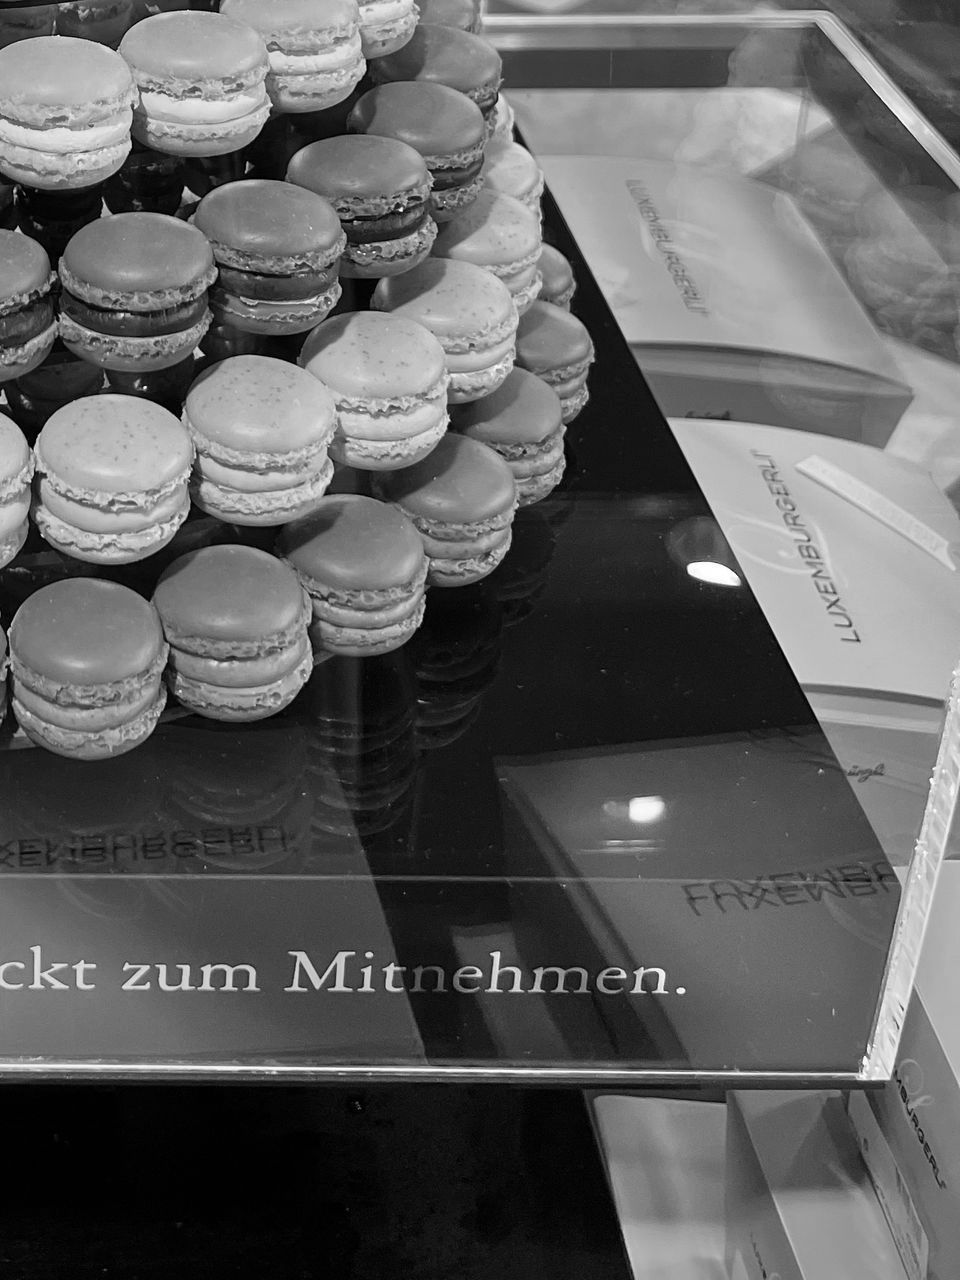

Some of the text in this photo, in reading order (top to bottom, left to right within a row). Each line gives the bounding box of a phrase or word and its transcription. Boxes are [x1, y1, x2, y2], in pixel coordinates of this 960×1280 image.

[752, 451, 861, 644] LUXEMBURGERLI
[121, 960, 261, 992] zum
[283, 950, 687, 995] Mitnehmen.
